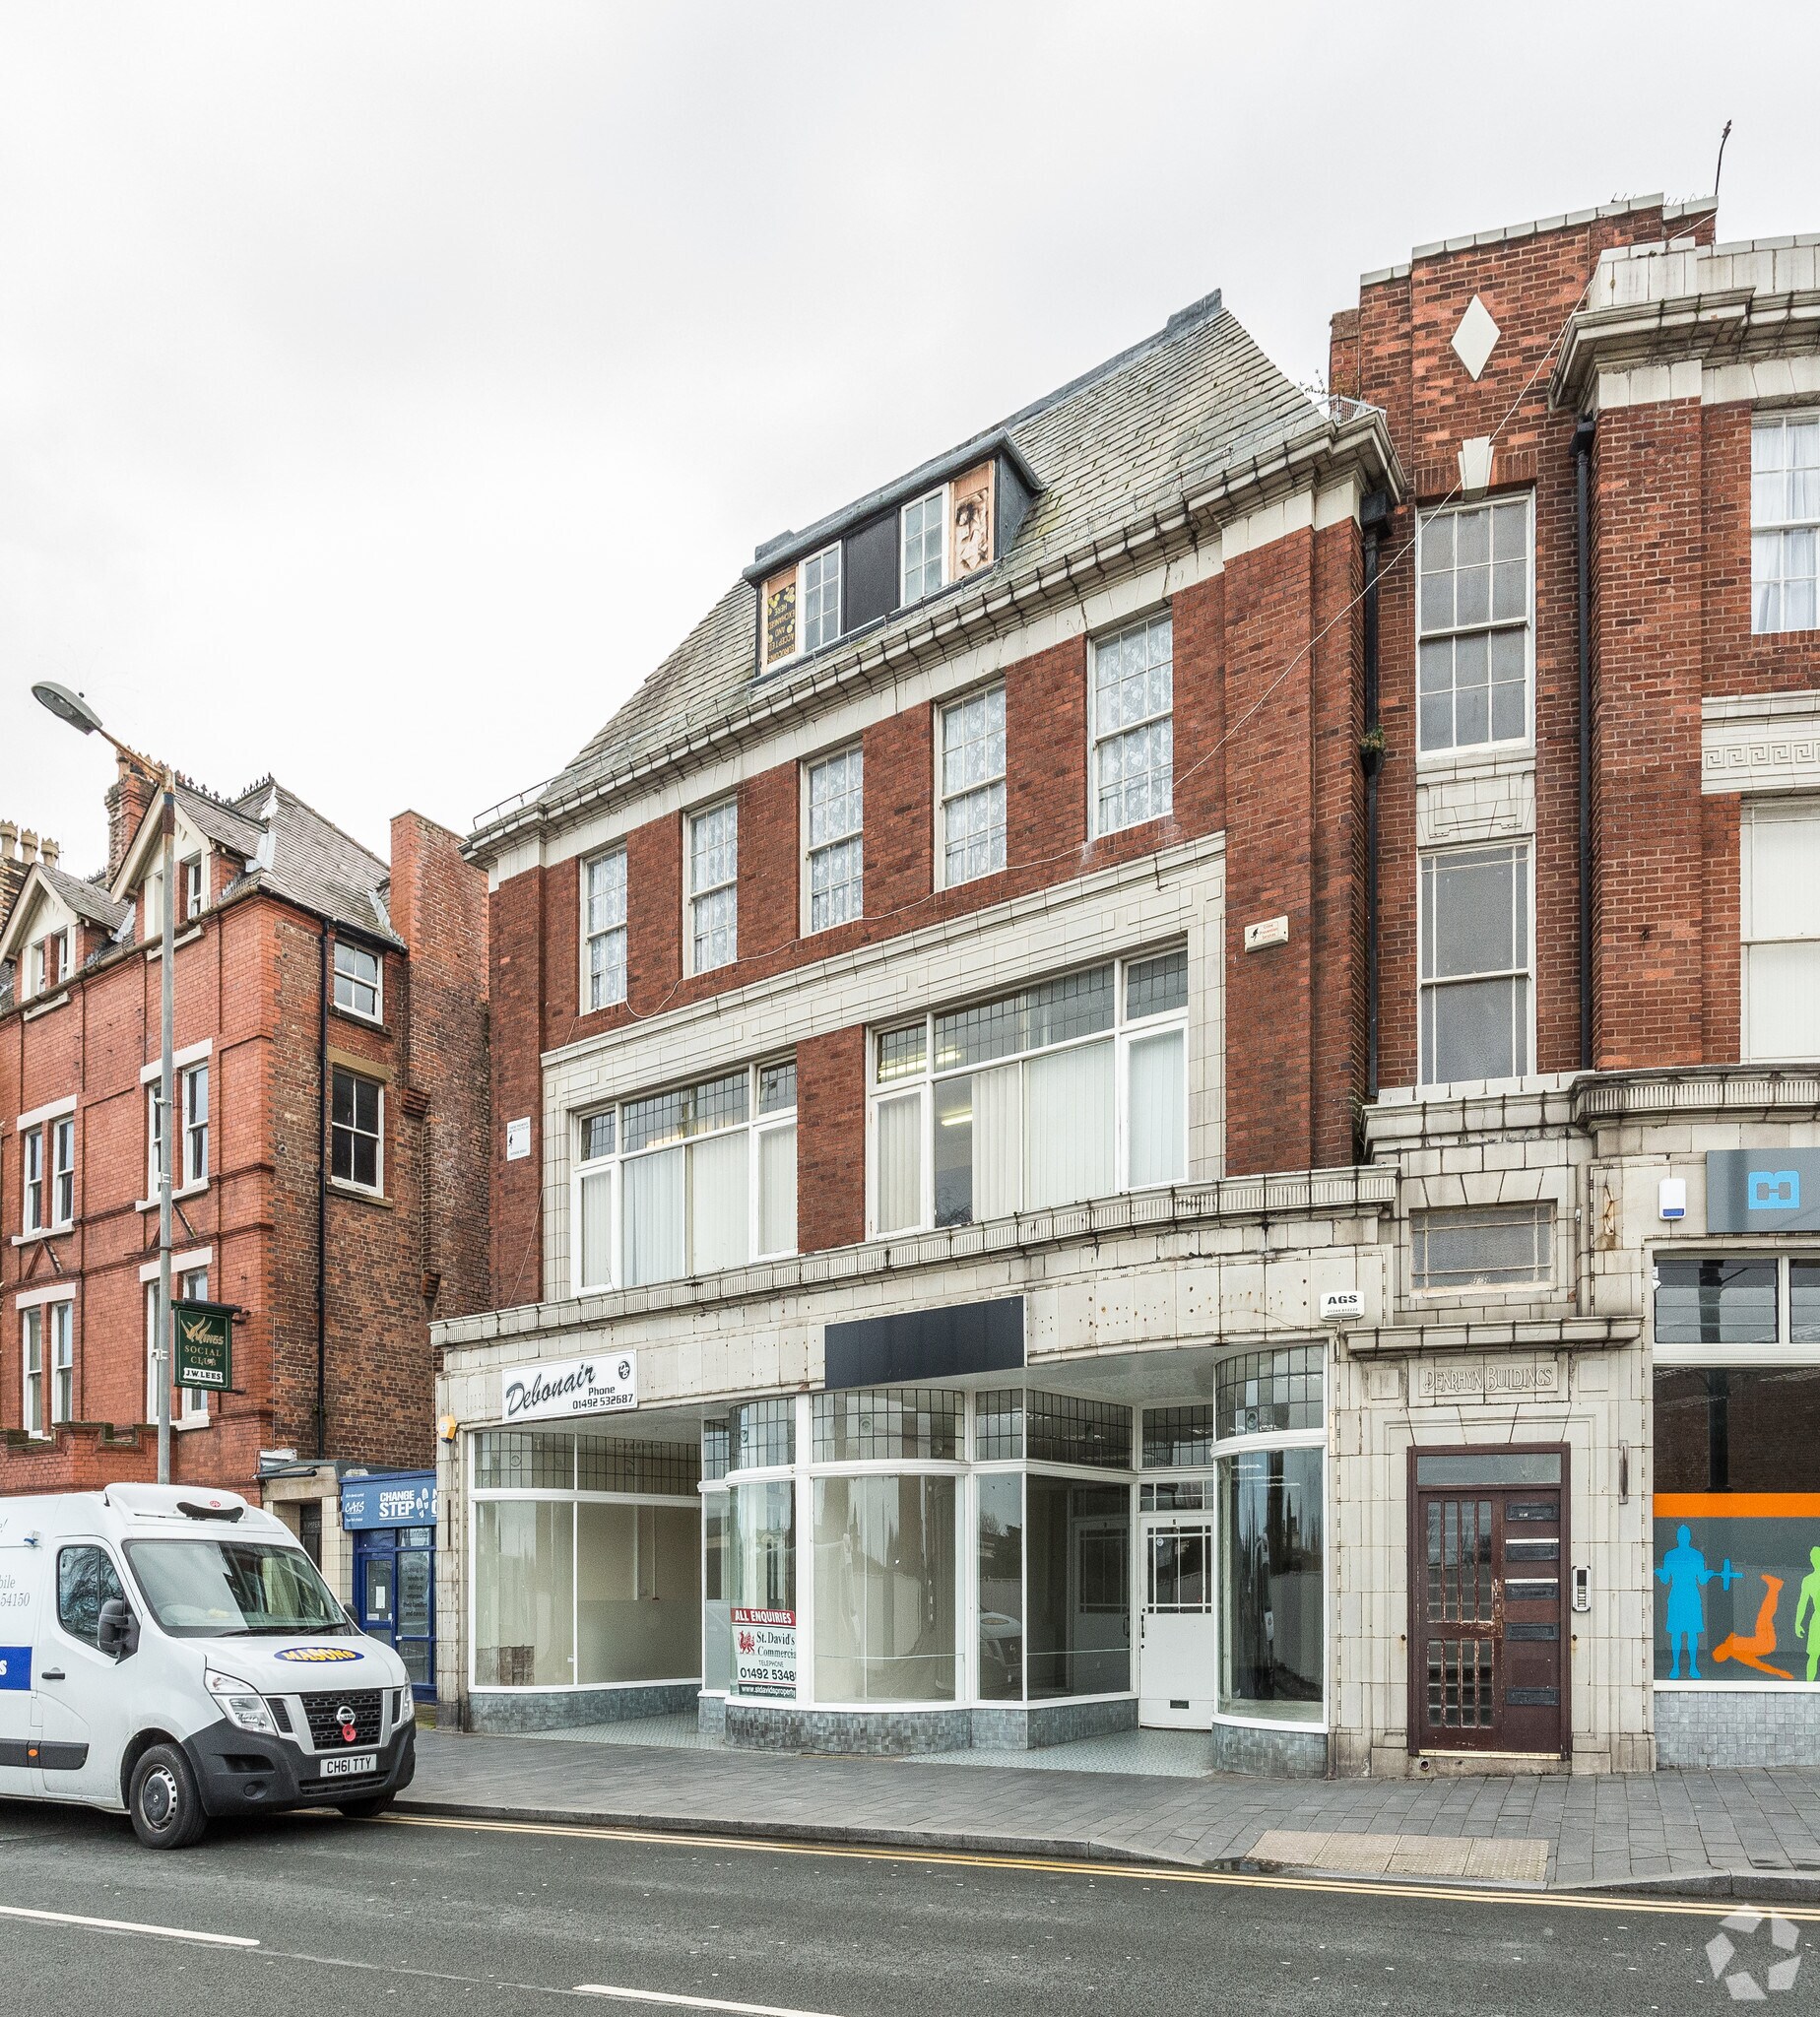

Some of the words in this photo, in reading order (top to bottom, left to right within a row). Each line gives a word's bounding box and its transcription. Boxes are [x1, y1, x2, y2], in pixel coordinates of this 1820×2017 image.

[1328, 1294, 1358, 1305] AGS
[184, 1344, 222, 1357] SOCIAL
[190, 1356, 217, 1367] CLUB
[506, 1363, 596, 1416] Debonair
[588, 1386, 616, 1397] Phone
[572, 1397, 598, 1410] 01492
[600, 1394, 634, 1407] 532687
[379, 1489, 415, 1502] CHANGE
[379, 1501, 415, 1518] STEP
[735, 1609, 749, 1622] ALL
[750, 1610, 792, 1624] ENQUIRIES
[282, 1647, 357, 1661] MASONS
[740, 1666, 769, 1680] 01492
[772, 1668, 796, 1682] 5348
[327, 1759, 351, 1774] CH61
[353, 1757, 371, 1771] TTY
